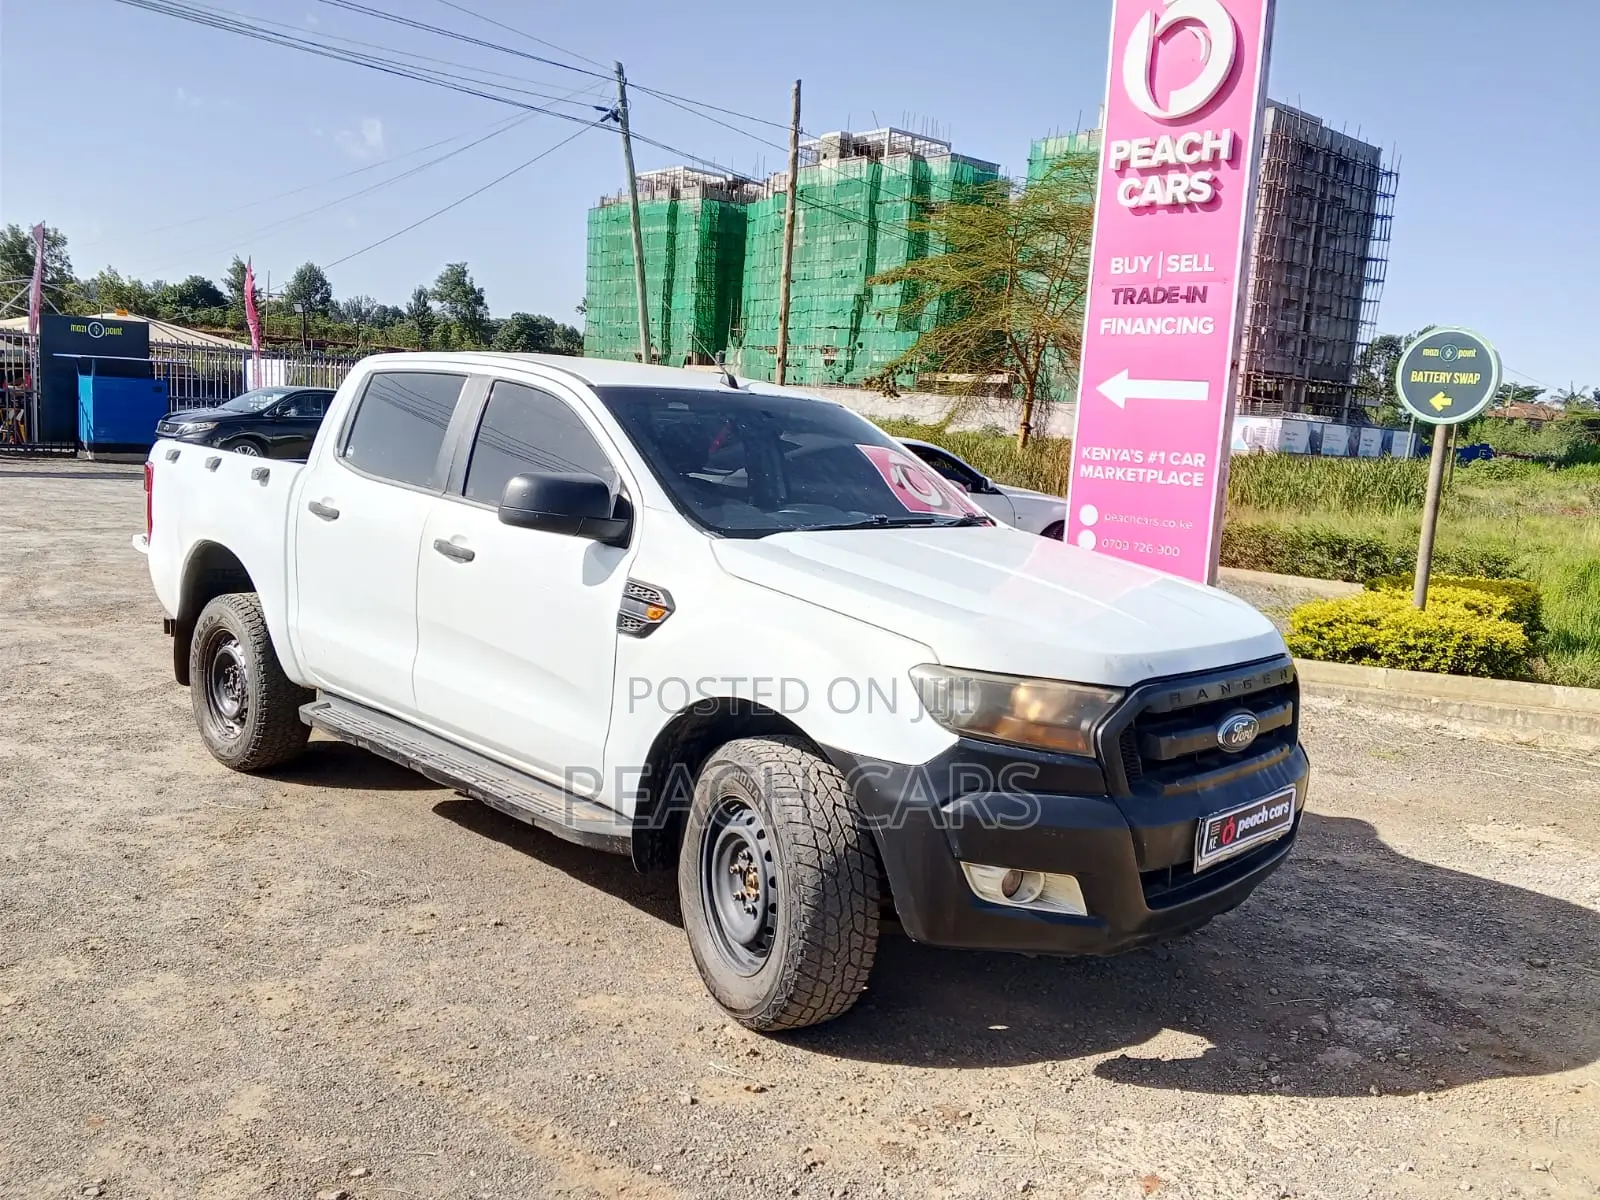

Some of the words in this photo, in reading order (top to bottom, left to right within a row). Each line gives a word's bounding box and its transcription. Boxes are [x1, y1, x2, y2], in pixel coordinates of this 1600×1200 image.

[1109, 128, 1234, 170] PEACH
[1116, 171, 1216, 209] CARS
[1110, 255, 1153, 275] BUY
[1166, 254, 1215, 273] SELL
[1112, 286, 1209, 305] TRADE-IN
[105, 327, 123, 336] point
[1100, 317, 1215, 336] FINANCING
[1411, 370, 1452, 383] BATTERY
[1453, 372, 1481, 385] SWAP
[1081, 447, 1144, 464] KENYA'S
[1148, 451, 1166, 465] #1
[1169, 453, 1206, 468] CAR
[1079, 465, 1205, 487] MARKETPLACE
[1168, 669, 1289, 705] RANGER
[1231, 721, 1255, 743] Ford
[1236, 805, 1268, 839] peach
[1269, 802, 1289, 819] cars
[1208, 836, 1218, 851] KE
